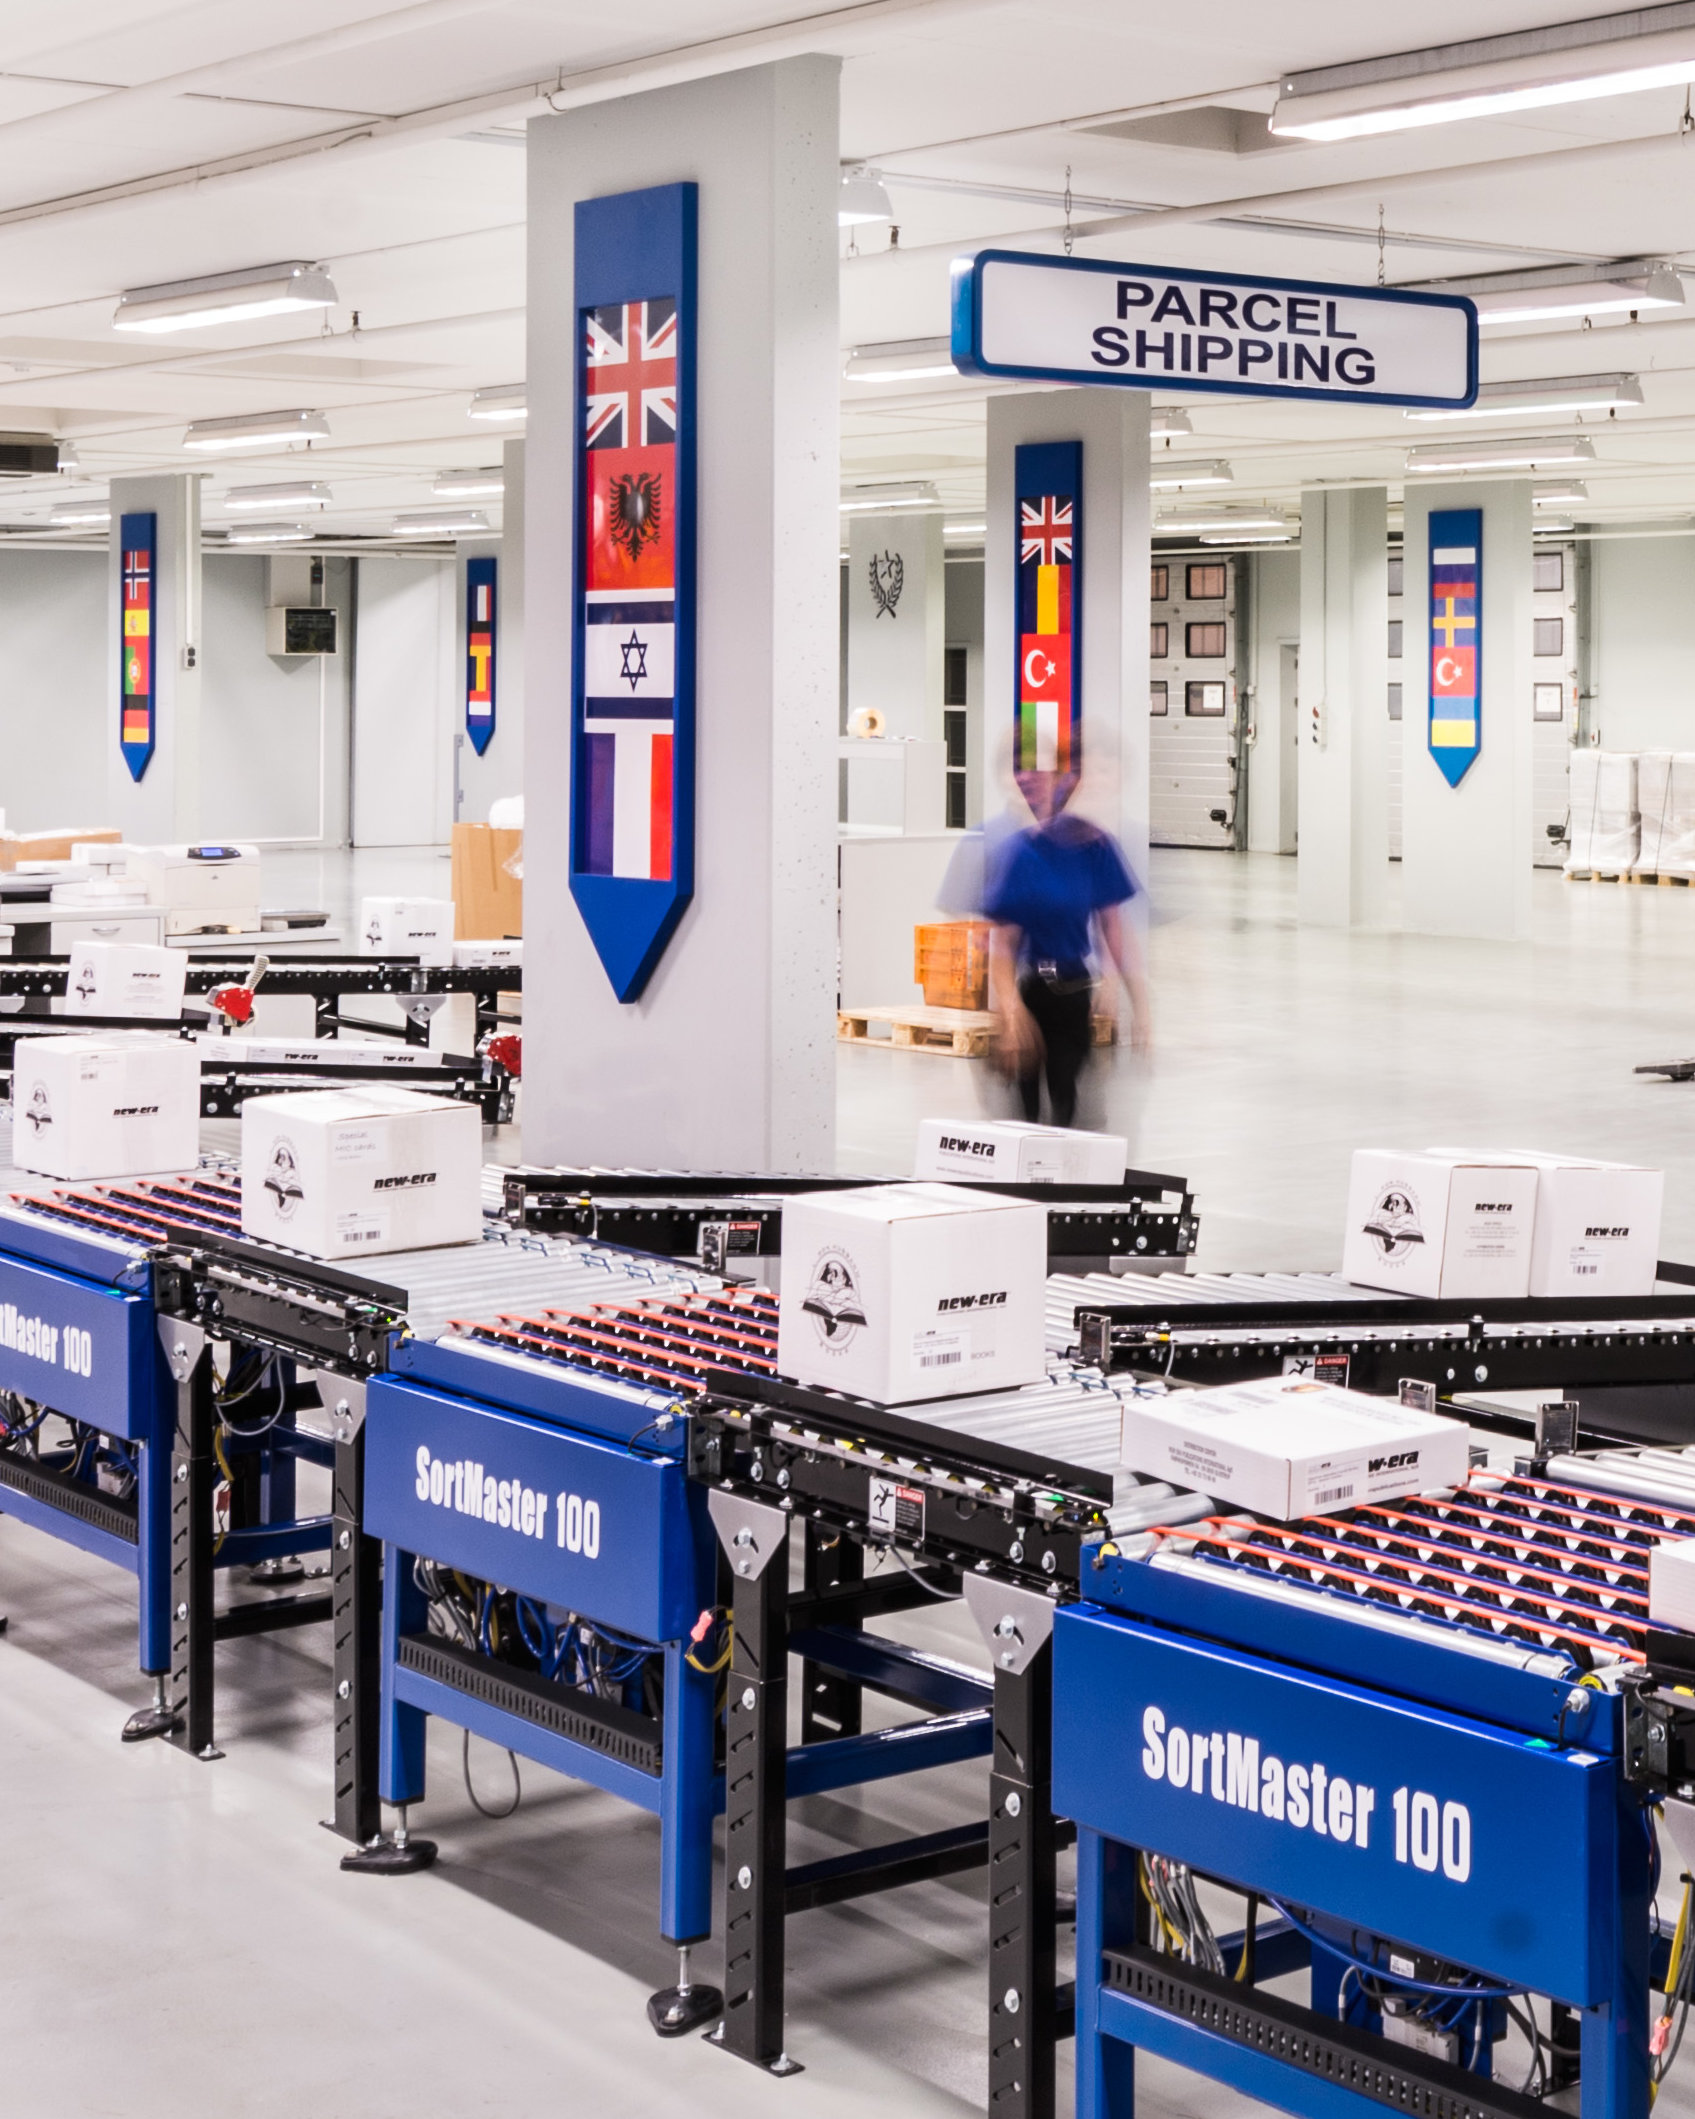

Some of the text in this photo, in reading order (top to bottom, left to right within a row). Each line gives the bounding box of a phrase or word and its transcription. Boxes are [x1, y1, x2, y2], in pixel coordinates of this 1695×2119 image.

[1117, 280, 1357, 340] PARCEL
[1091, 326, 1376, 386] SHIPPING
[63, 1325, 91, 1377] 100
[415, 1445, 600, 1559] SortMaster 100
[1142, 1705, 1471, 1883] SortMaster 100
